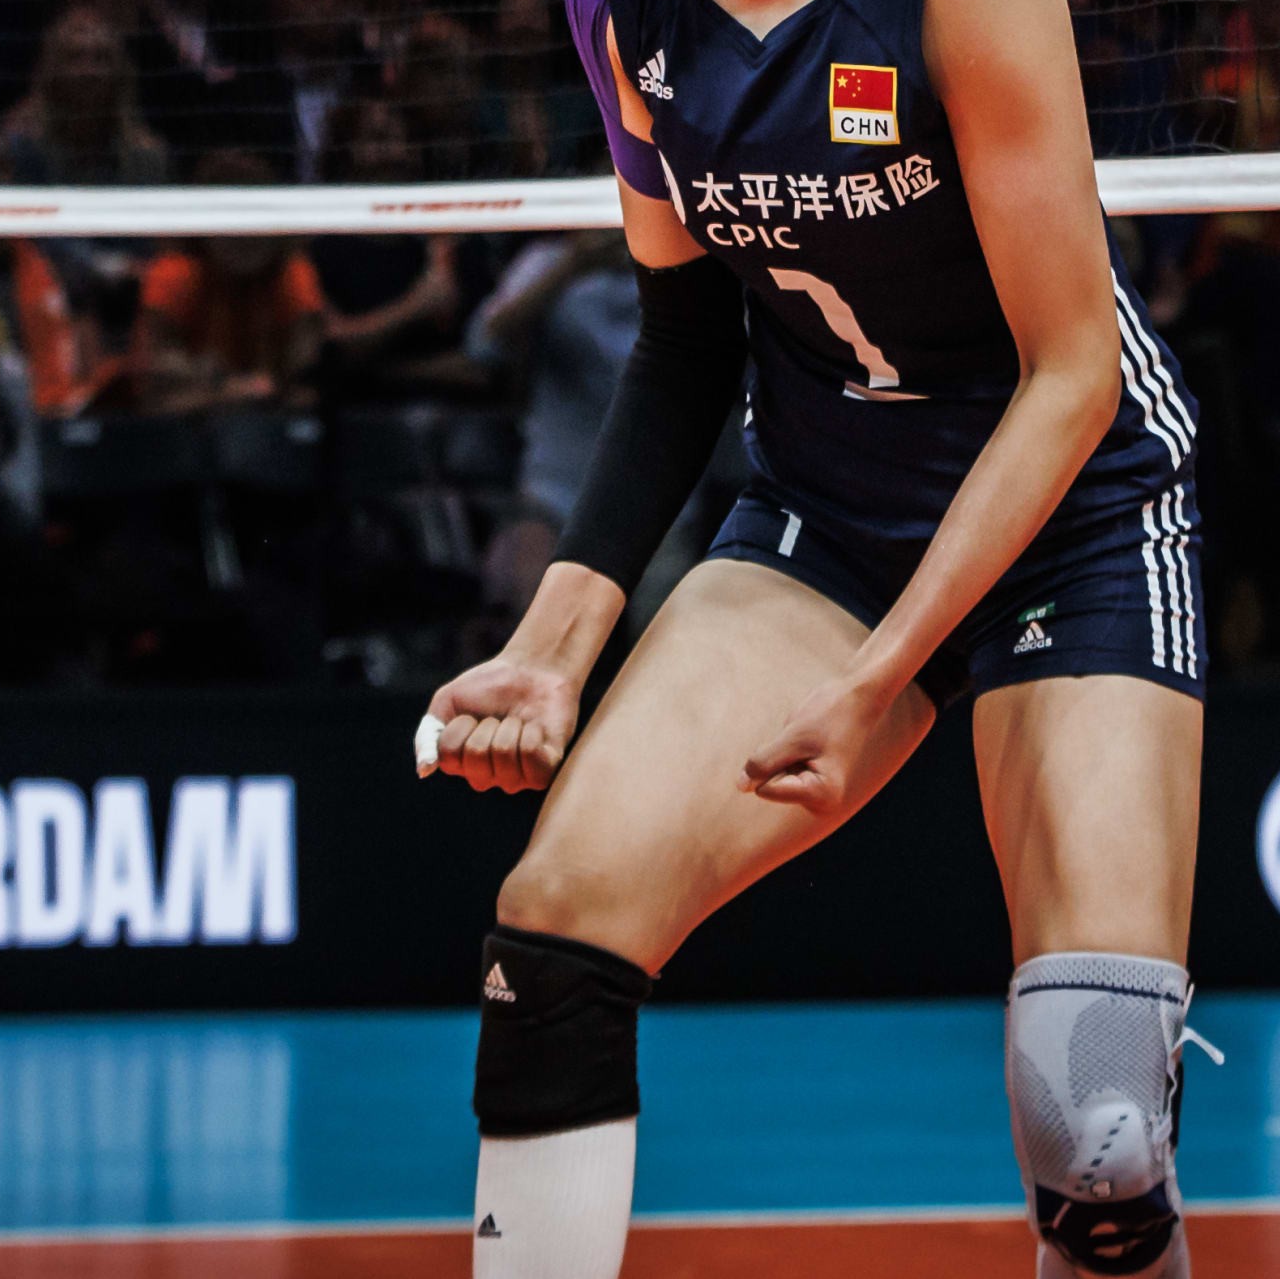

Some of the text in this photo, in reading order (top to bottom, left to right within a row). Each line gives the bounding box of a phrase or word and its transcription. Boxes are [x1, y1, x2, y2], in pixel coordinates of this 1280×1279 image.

[839, 115, 890, 137] CHN
[691, 153, 941, 221] 太平洋保险
[705, 222, 801, 250] CPIC
[780, 508, 803, 558] 1
